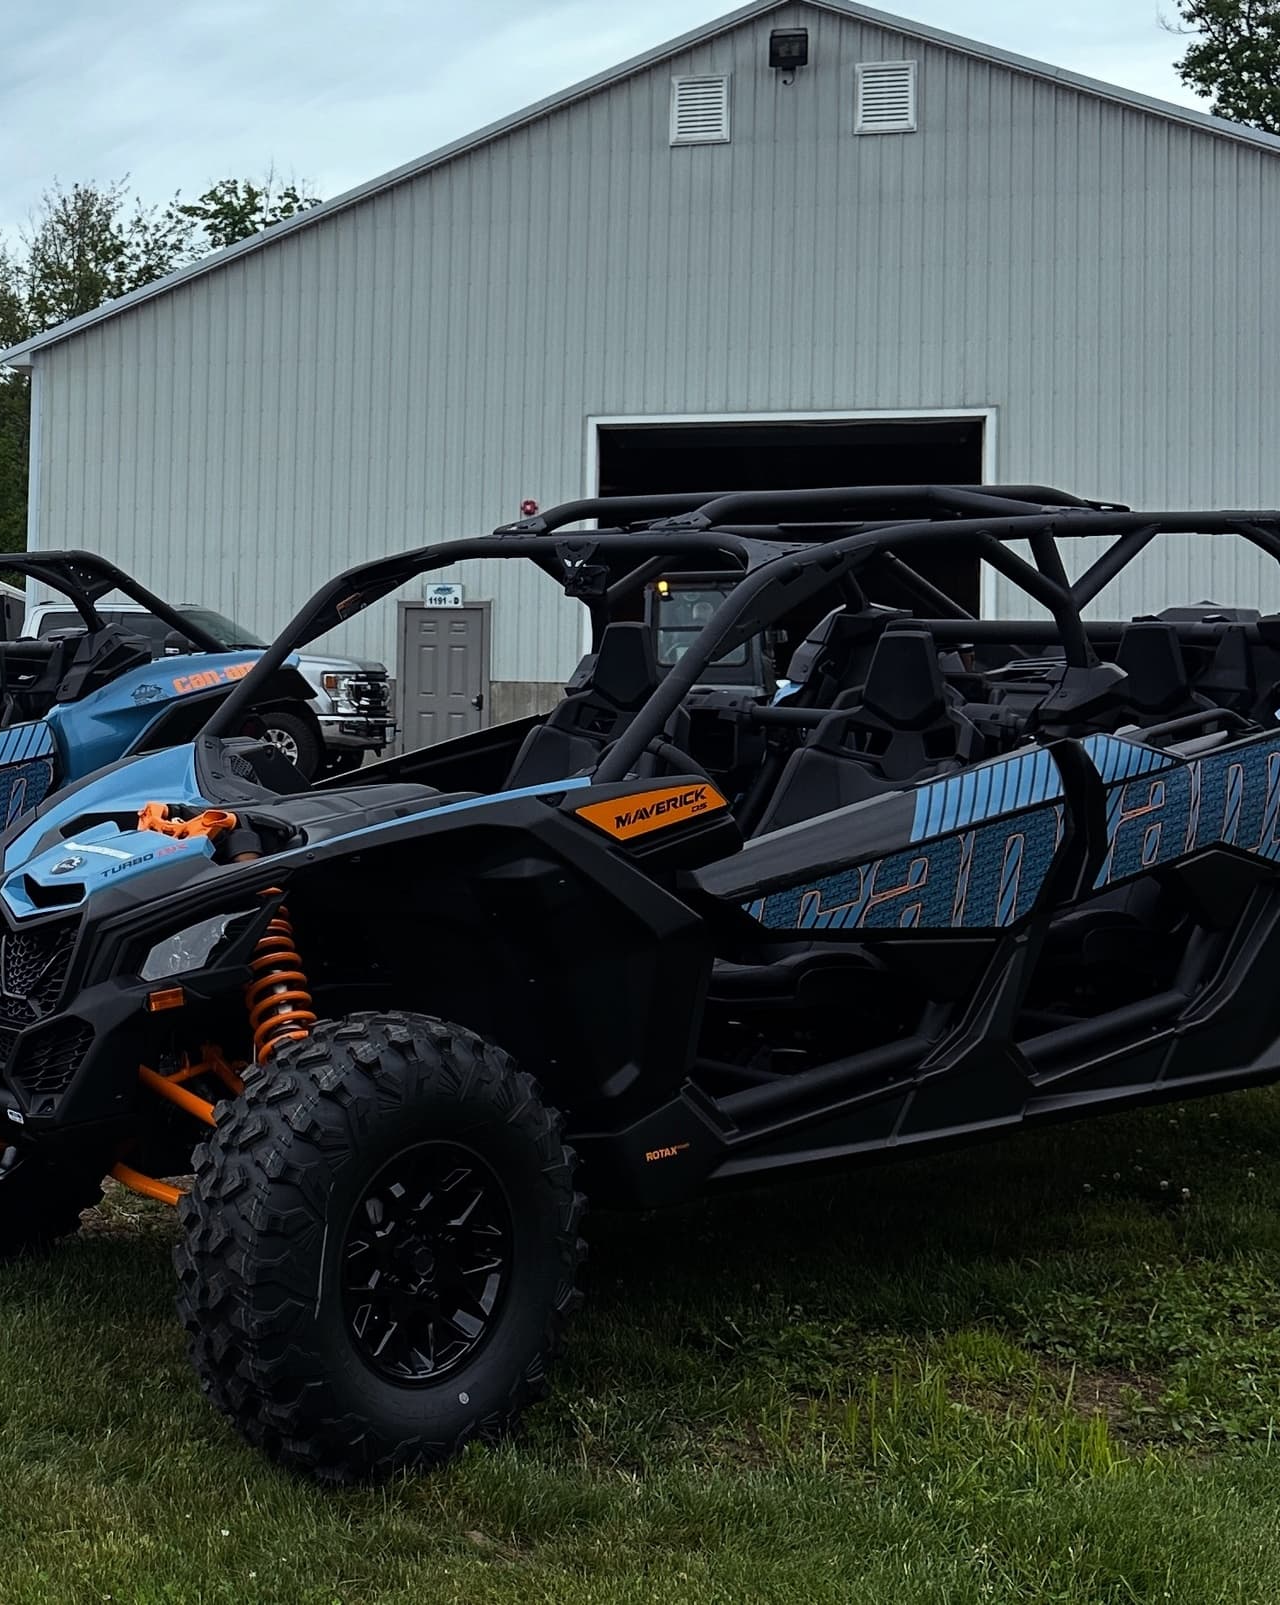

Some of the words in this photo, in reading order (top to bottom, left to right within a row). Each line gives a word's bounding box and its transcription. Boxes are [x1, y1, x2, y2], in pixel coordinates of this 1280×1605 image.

[429, 597, 446, 605] 1191
[614, 786, 707, 830] MAVERICK
[691, 802, 708, 813] DS
[100, 853, 154, 878] TURBO
[646, 1146, 678, 1162] ROTAX
